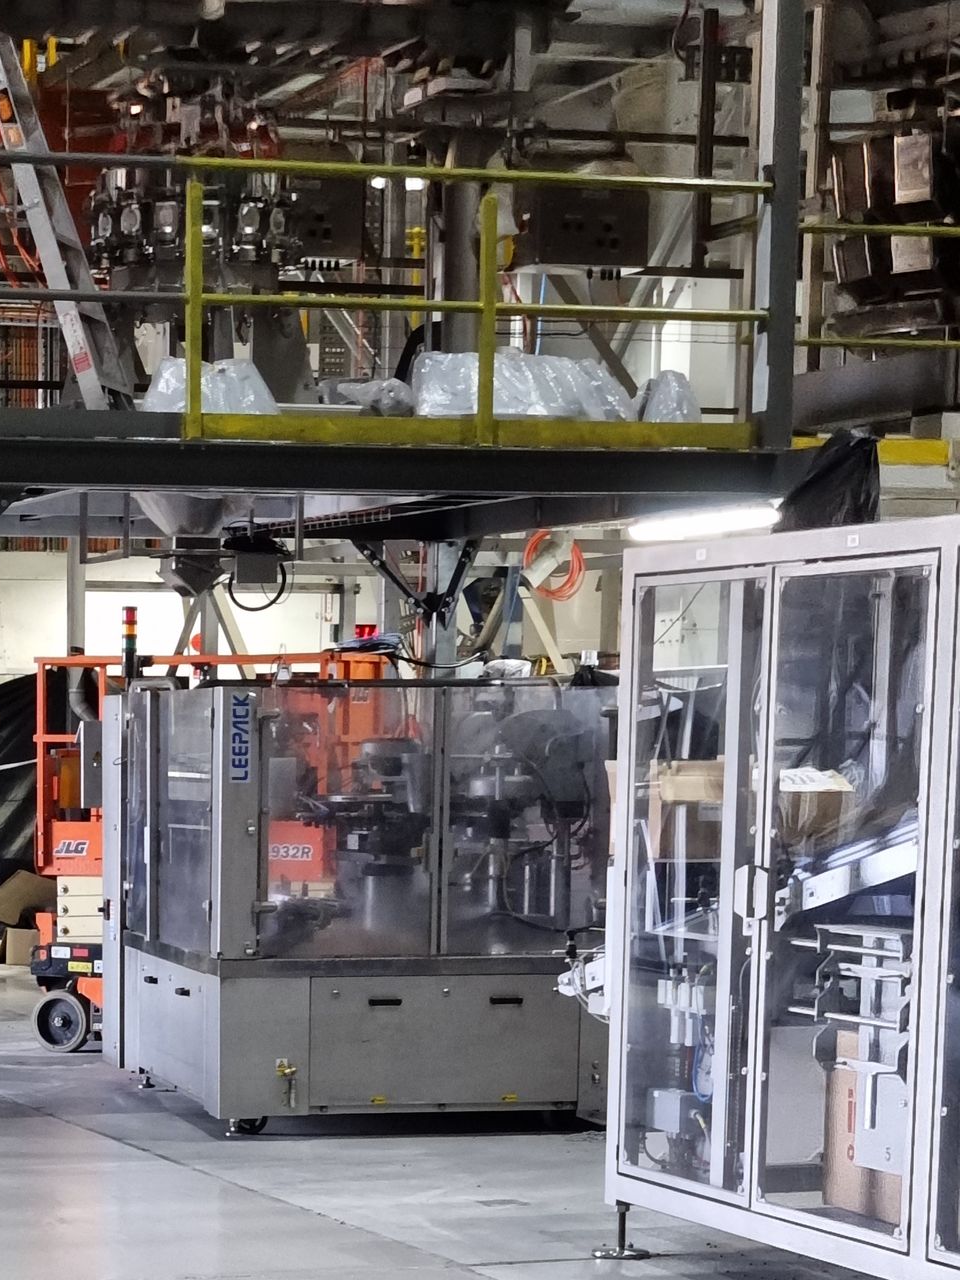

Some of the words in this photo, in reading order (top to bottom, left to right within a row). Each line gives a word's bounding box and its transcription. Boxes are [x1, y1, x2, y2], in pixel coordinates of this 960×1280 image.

[231, 694, 250, 781] LEEPACK
[54, 840, 88, 855] JLG
[269, 844, 313, 860] 932R
